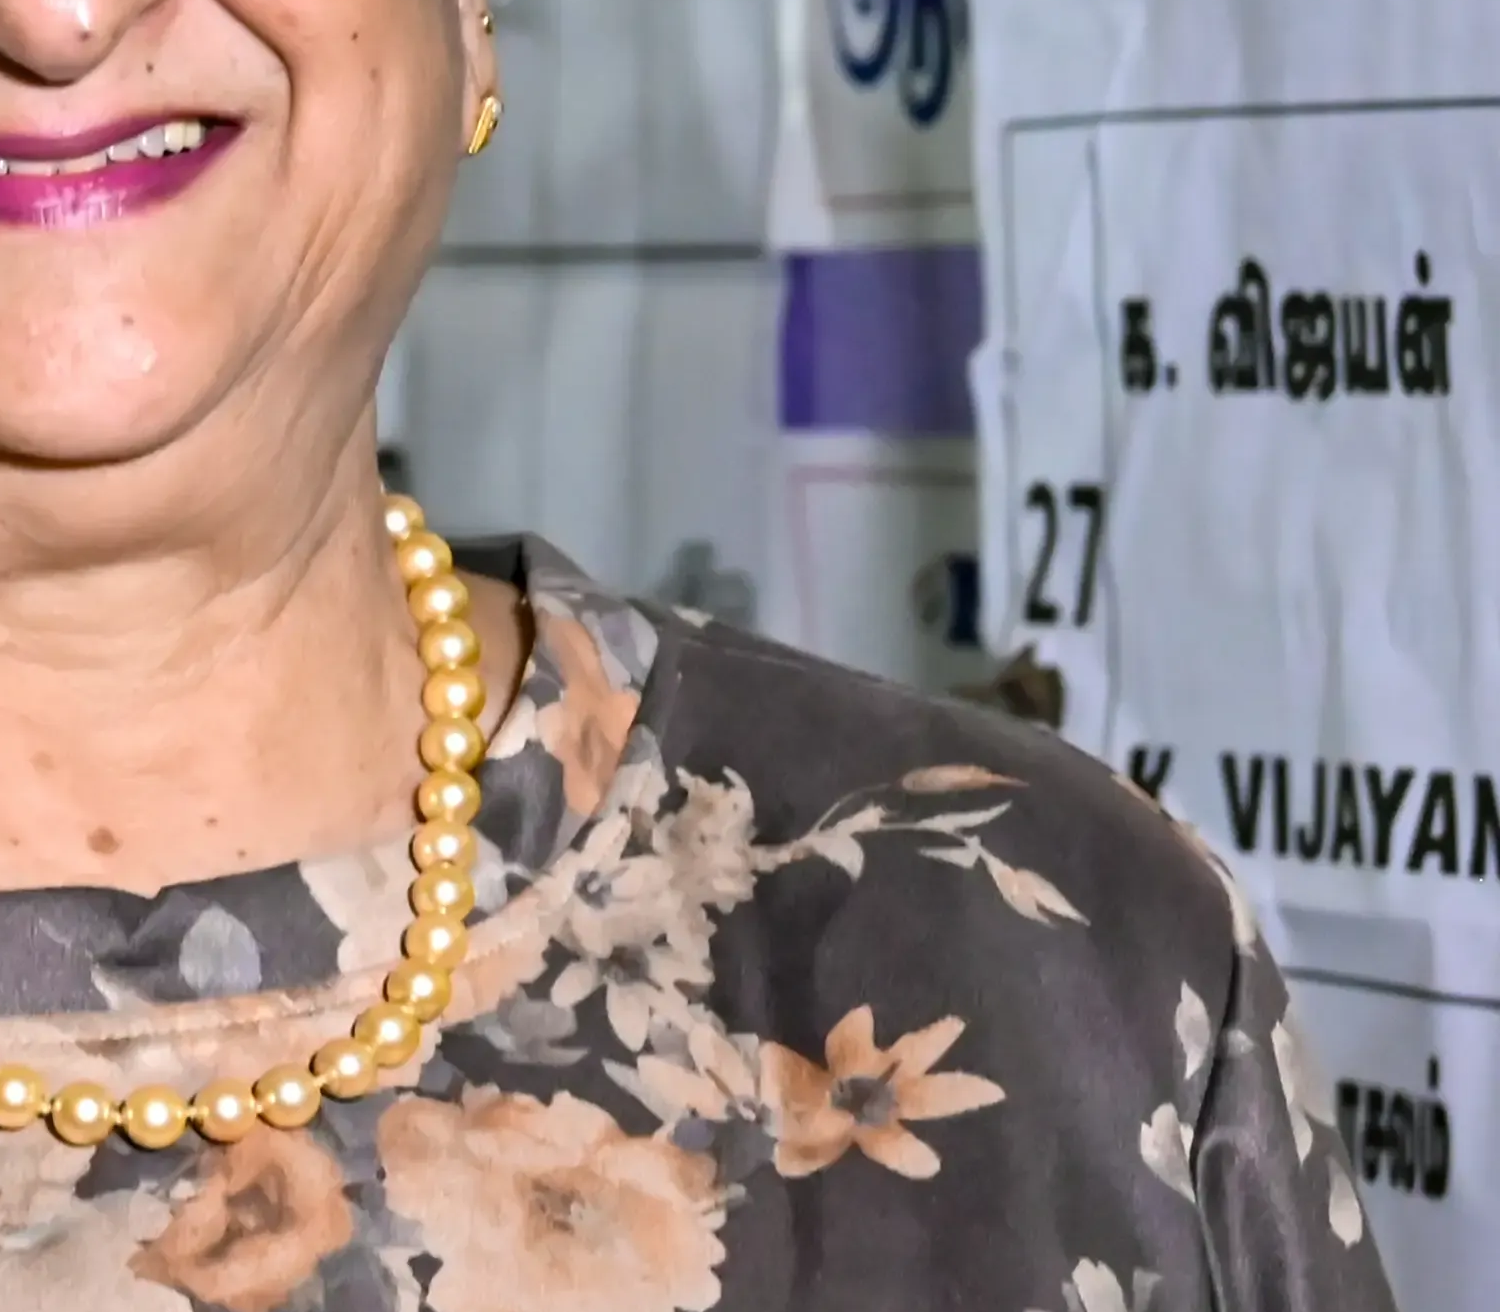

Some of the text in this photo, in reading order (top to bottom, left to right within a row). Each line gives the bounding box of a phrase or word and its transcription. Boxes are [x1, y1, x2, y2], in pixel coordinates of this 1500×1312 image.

[1208, 249, 1454, 405] விஜயன்
[1024, 483, 1102, 625] 27
[1220, 750, 1500, 879] VIJAYAN
